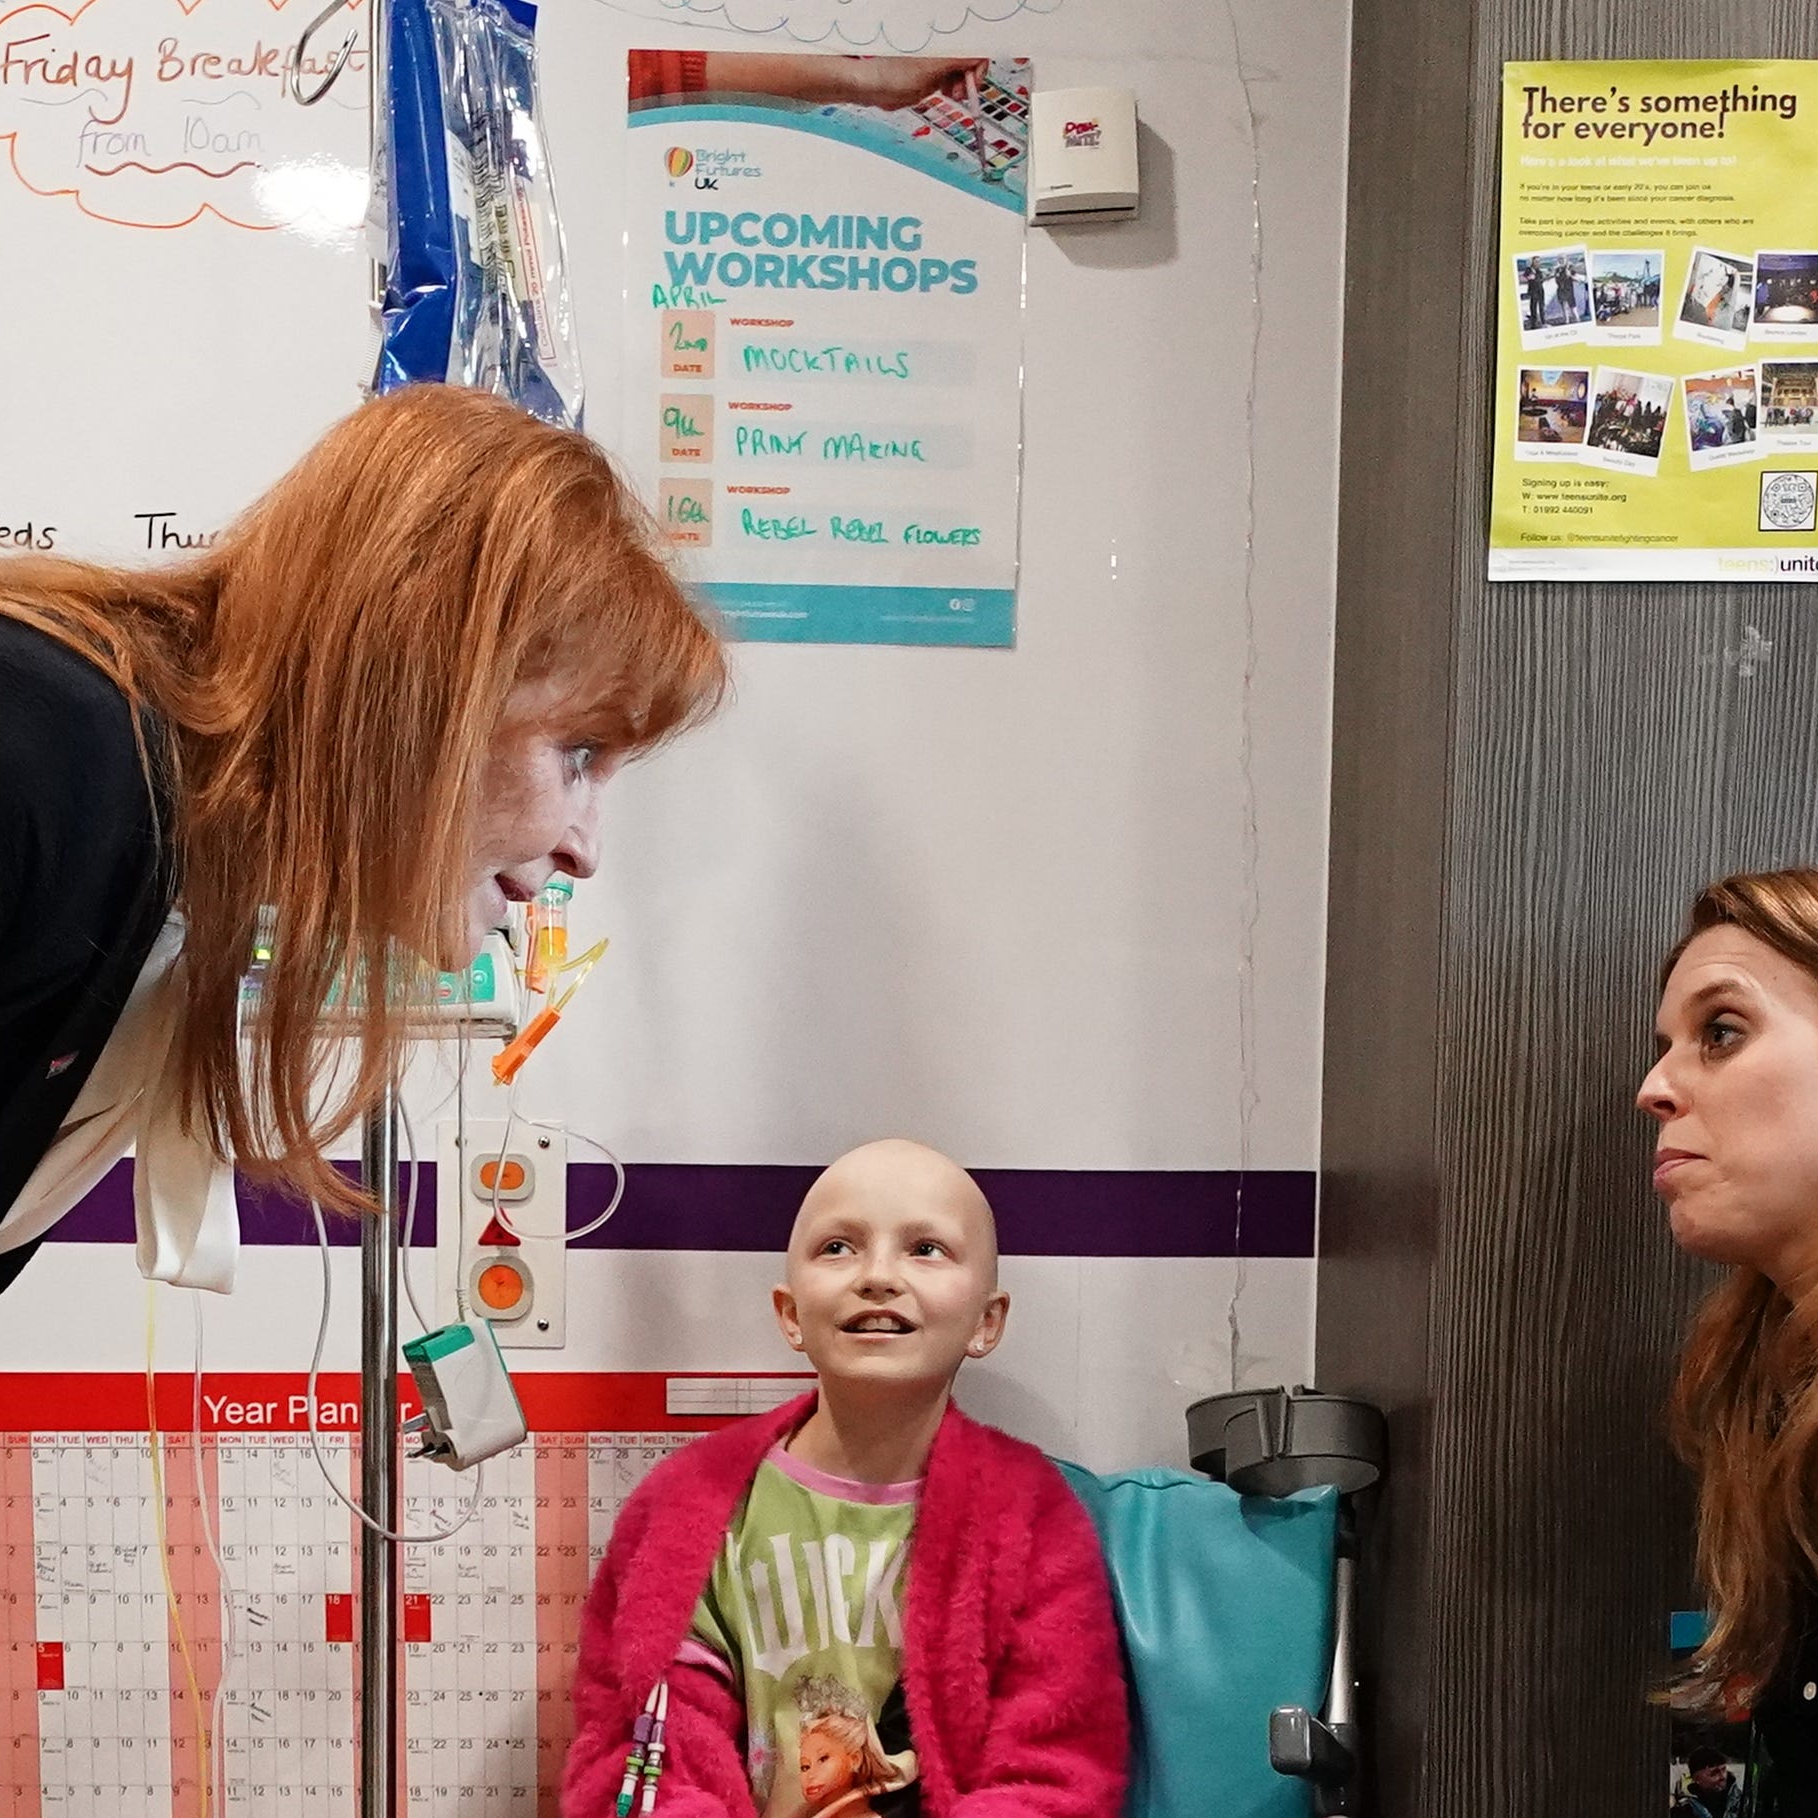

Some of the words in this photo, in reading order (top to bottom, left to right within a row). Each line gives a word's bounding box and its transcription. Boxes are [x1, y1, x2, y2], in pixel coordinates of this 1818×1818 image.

[0, 33, 133, 124] Friday
[157, 35, 371, 99] Breakfast
[1522, 86, 1630, 117] There's
[1639, 84, 1798, 119] something
[77, 117, 153, 168] from
[184, 114, 265, 154] 10am
[1522, 112, 1567, 139] for
[1574, 112, 1725, 147] everyone!
[695, 149, 747, 165] Bright
[695, 164, 762, 178] Futures
[695, 177, 719, 191] UK
[664, 210, 924, 251] UPCOMING
[663, 251, 980, 295] WORKSHOPS
[651, 284, 727, 309] APRIL
[730, 318, 795, 328] WORKSHOP
[673, 364, 702, 373] DATE
[744, 345, 909, 379] MOCKTAILS
[728, 402, 793, 412] WORKSHOP
[672, 448, 701, 457] DATE
[736, 427, 809, 456] PRINT
[823, 433, 928, 462] MAKING
[726, 485, 791, 495] WORKSHOP
[1522, 478, 1558, 489] Signing
[1560, 480, 1571, 489] up
[1573, 479, 1581, 488] is
[1584, 480, 1610, 489] easy:
[1533, 505, 1560, 515] 01992
[741, 508, 818, 541] REBEL
[903, 524, 982, 547] FLOWERS
[203, 1395, 278, 1425] Year
[288, 1395, 412, 1425] Planr
[726, 1532, 912, 1681] WICK
